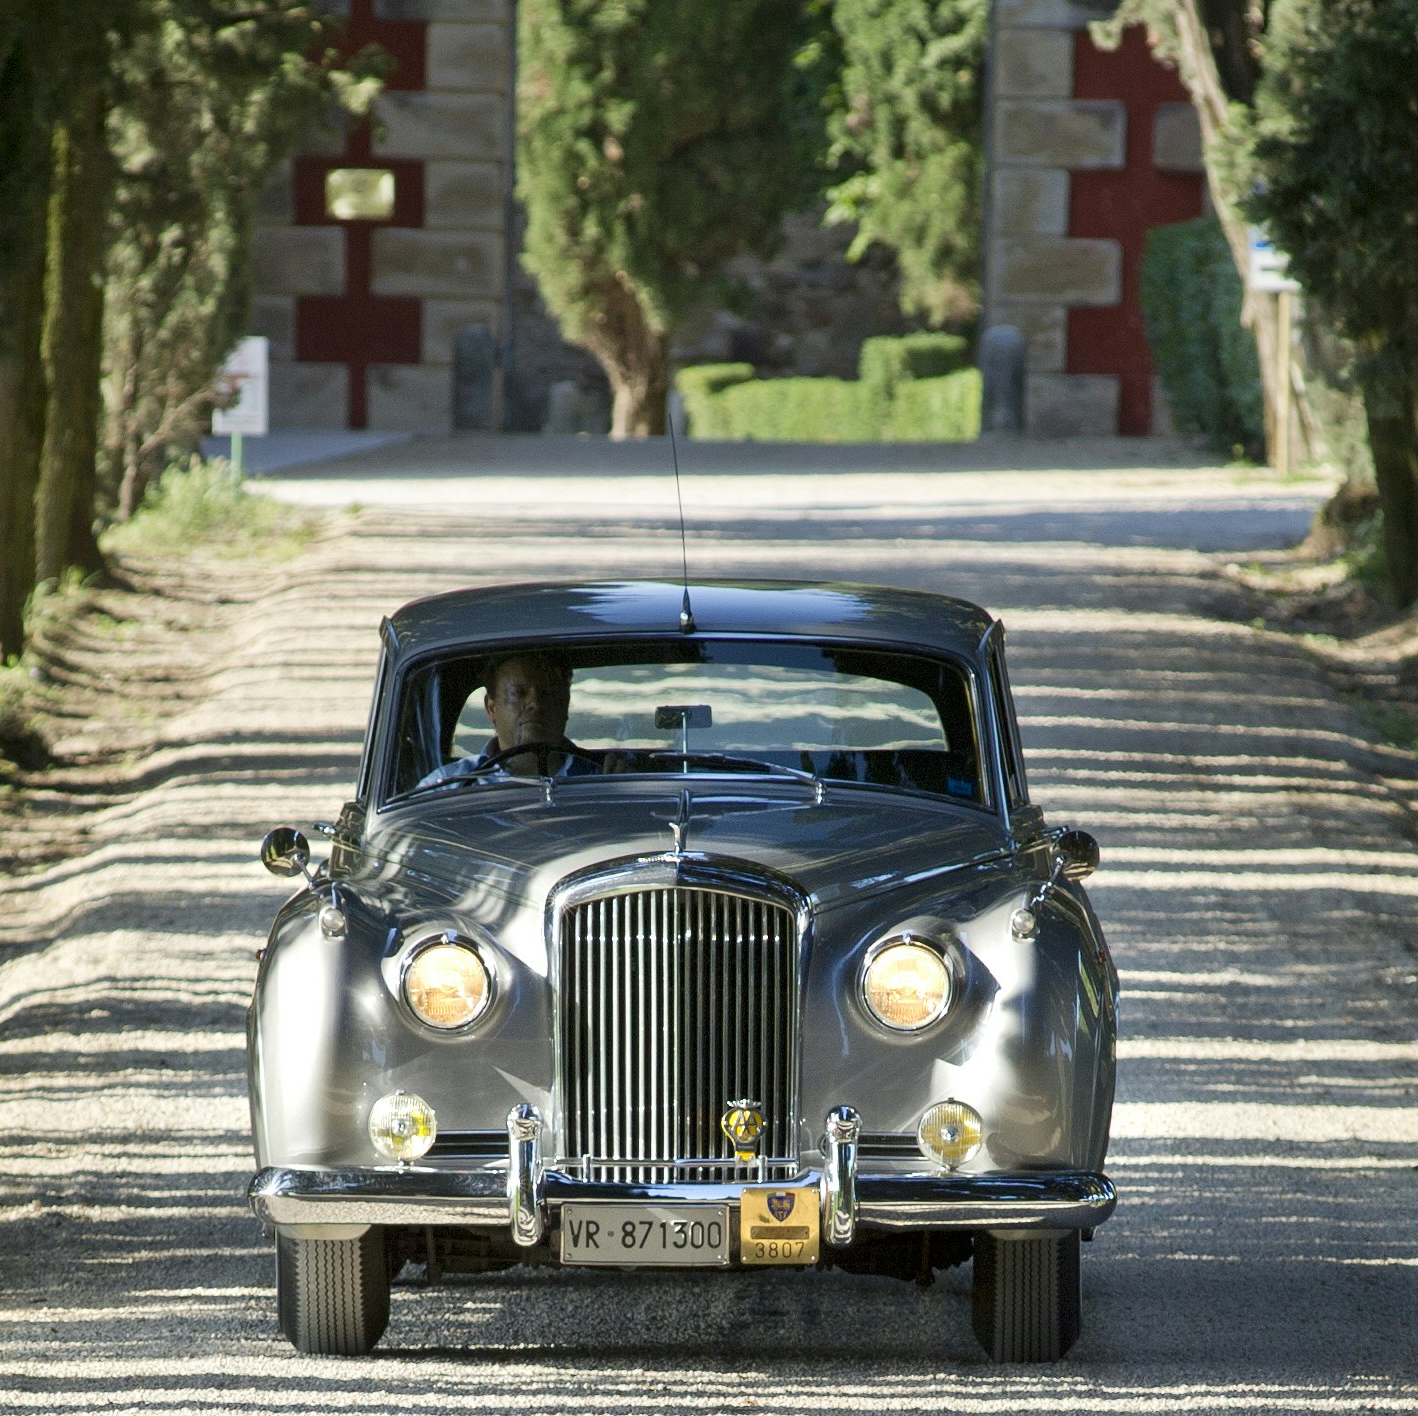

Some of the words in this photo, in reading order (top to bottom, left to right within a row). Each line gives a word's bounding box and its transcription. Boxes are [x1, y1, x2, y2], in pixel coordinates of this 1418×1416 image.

[569, 1220, 600, 1249] VR
[621, 1220, 722, 1249] 871300
[755, 1242, 805, 1259] 3807
